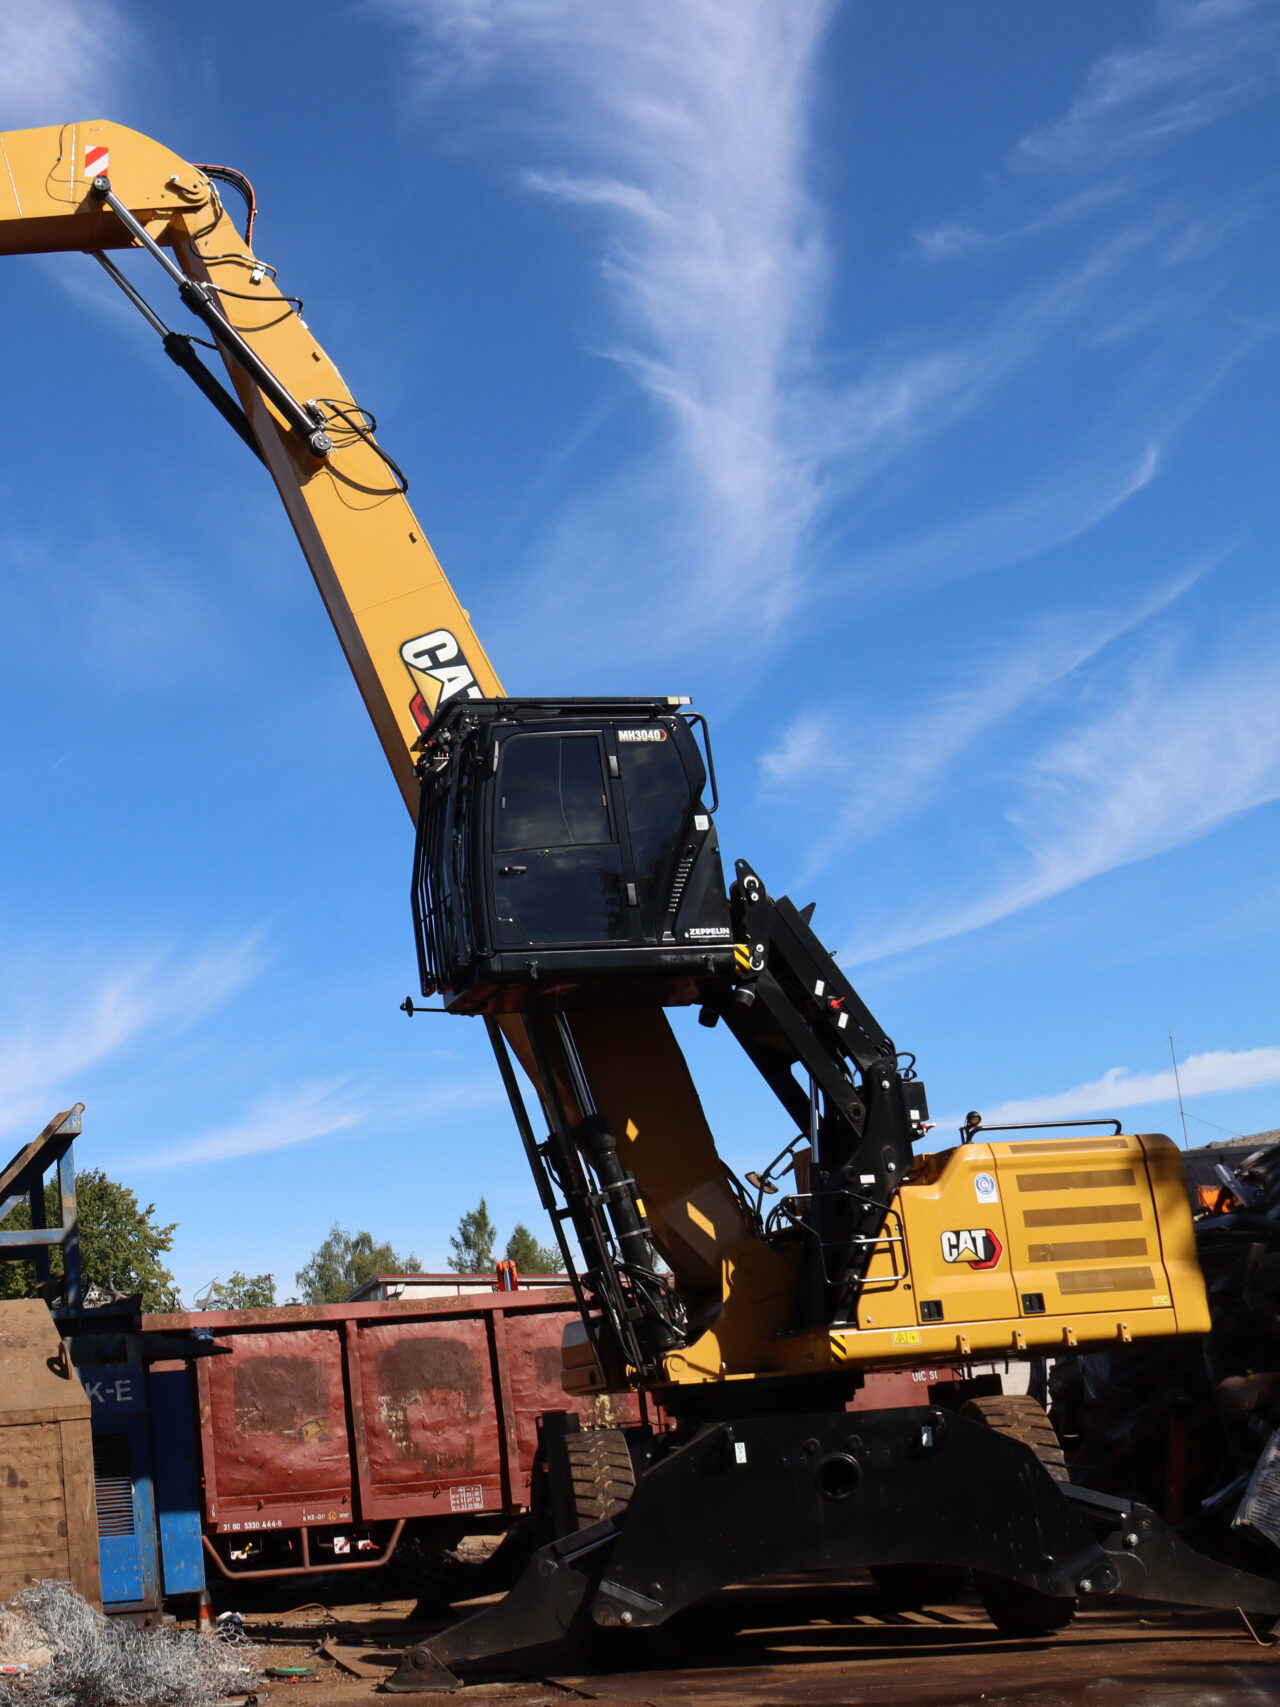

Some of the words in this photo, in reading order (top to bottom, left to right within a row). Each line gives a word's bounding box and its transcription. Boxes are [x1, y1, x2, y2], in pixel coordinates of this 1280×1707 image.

[618, 730, 660, 742] MH3040
[689, 927, 730, 936] ZEPPELIN
[941, 1229, 986, 1262] CAT
[911, 1371, 927, 1382] UIC
[223, 1523, 231, 1531] 31
[244, 1521, 260, 1529] 5330
[262, 1520, 283, 1528] 444-6
